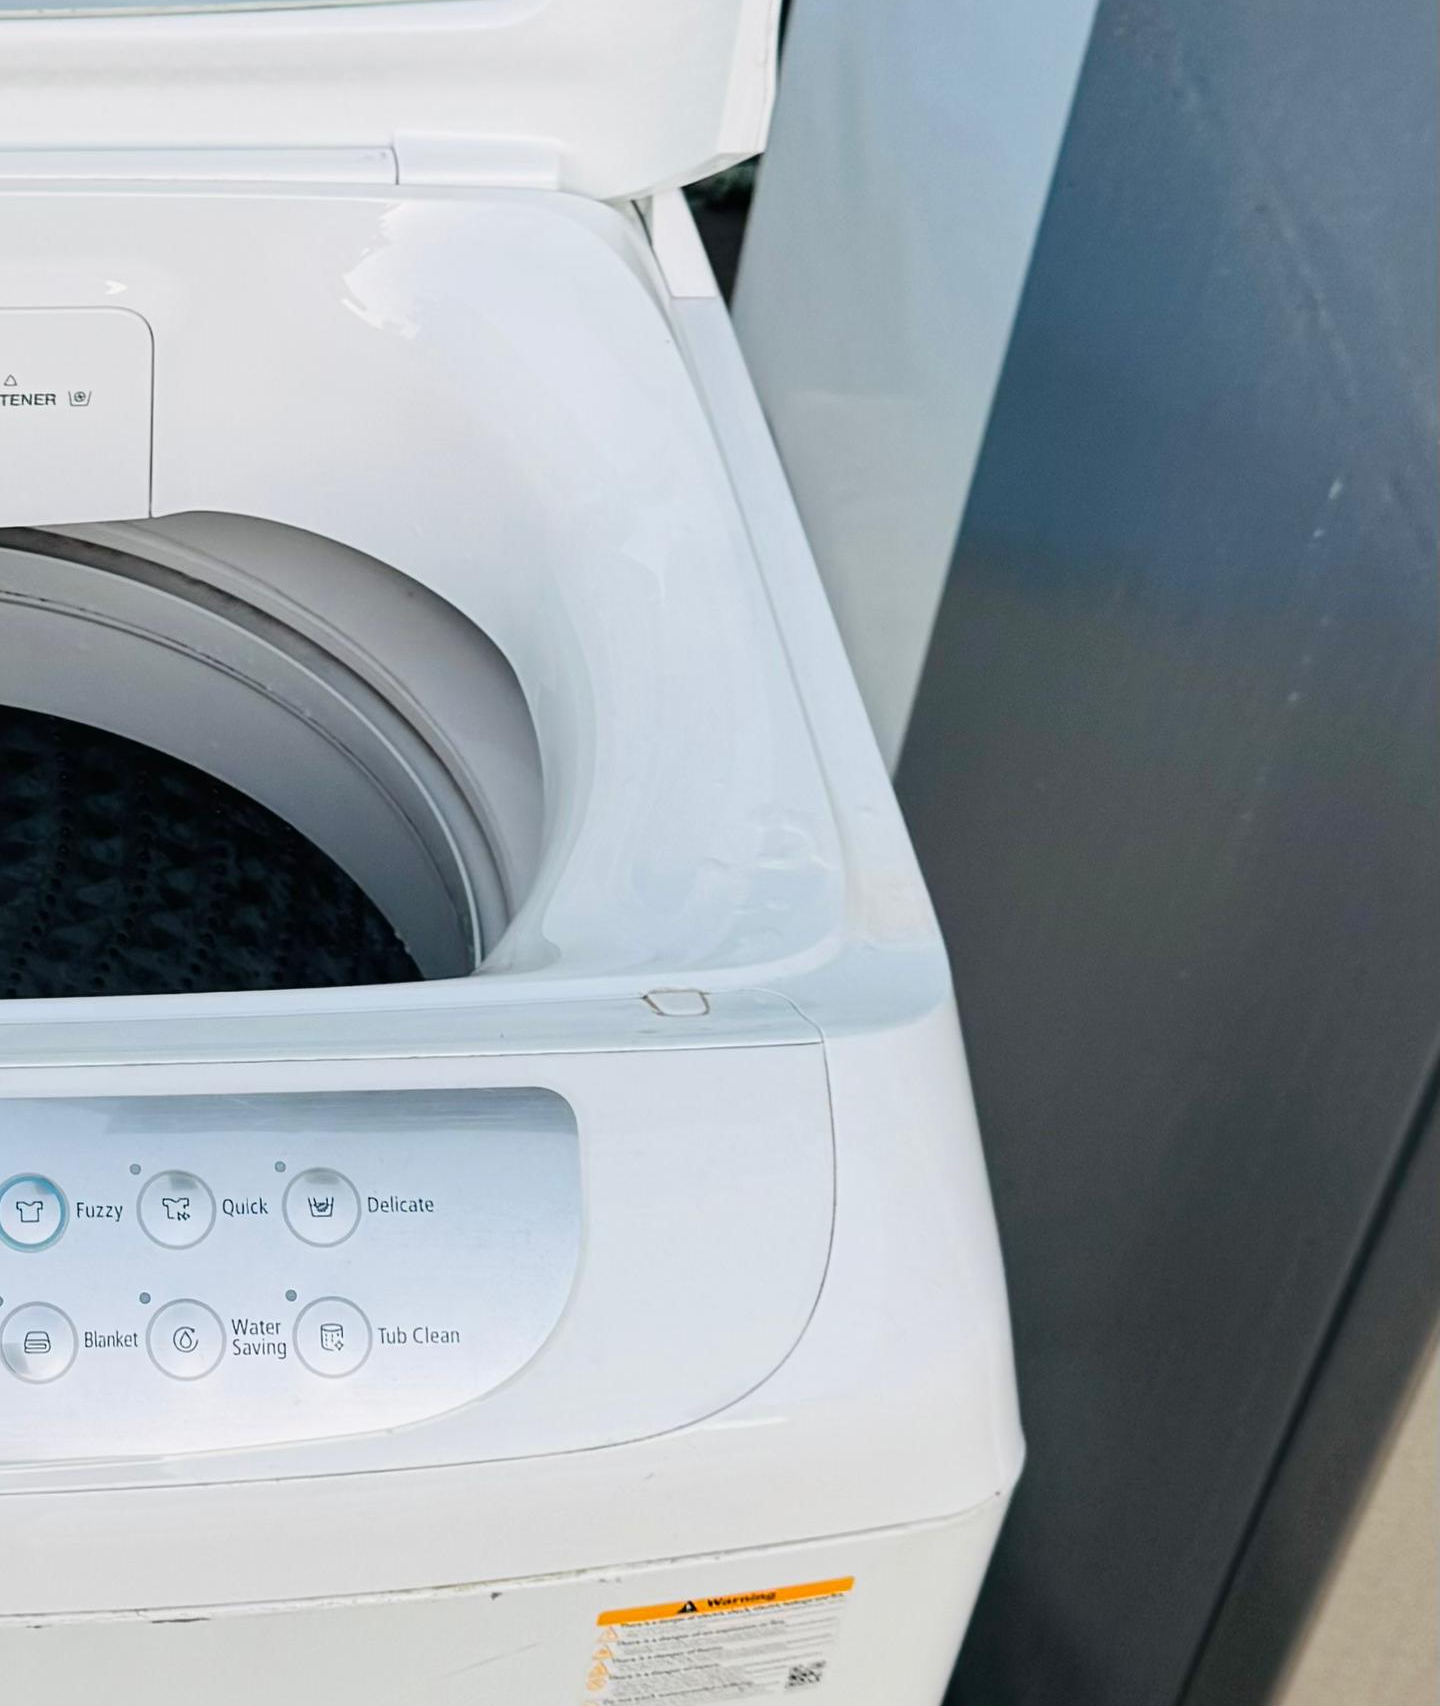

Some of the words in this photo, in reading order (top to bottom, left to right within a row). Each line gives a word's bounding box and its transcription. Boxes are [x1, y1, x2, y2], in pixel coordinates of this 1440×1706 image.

[76, 1201, 123, 1223] Fuzzy
[222, 1197, 269, 1218] Quick
[367, 1195, 435, 1214] Delicate
[231, 1318, 281, 1337] Water
[377, 1326, 407, 1345] Tub
[412, 1326, 460, 1345] Clean
[84, 1330, 139, 1349] Blanket
[232, 1337, 287, 1360] Saving
[706, 1591, 777, 1609] Warning
